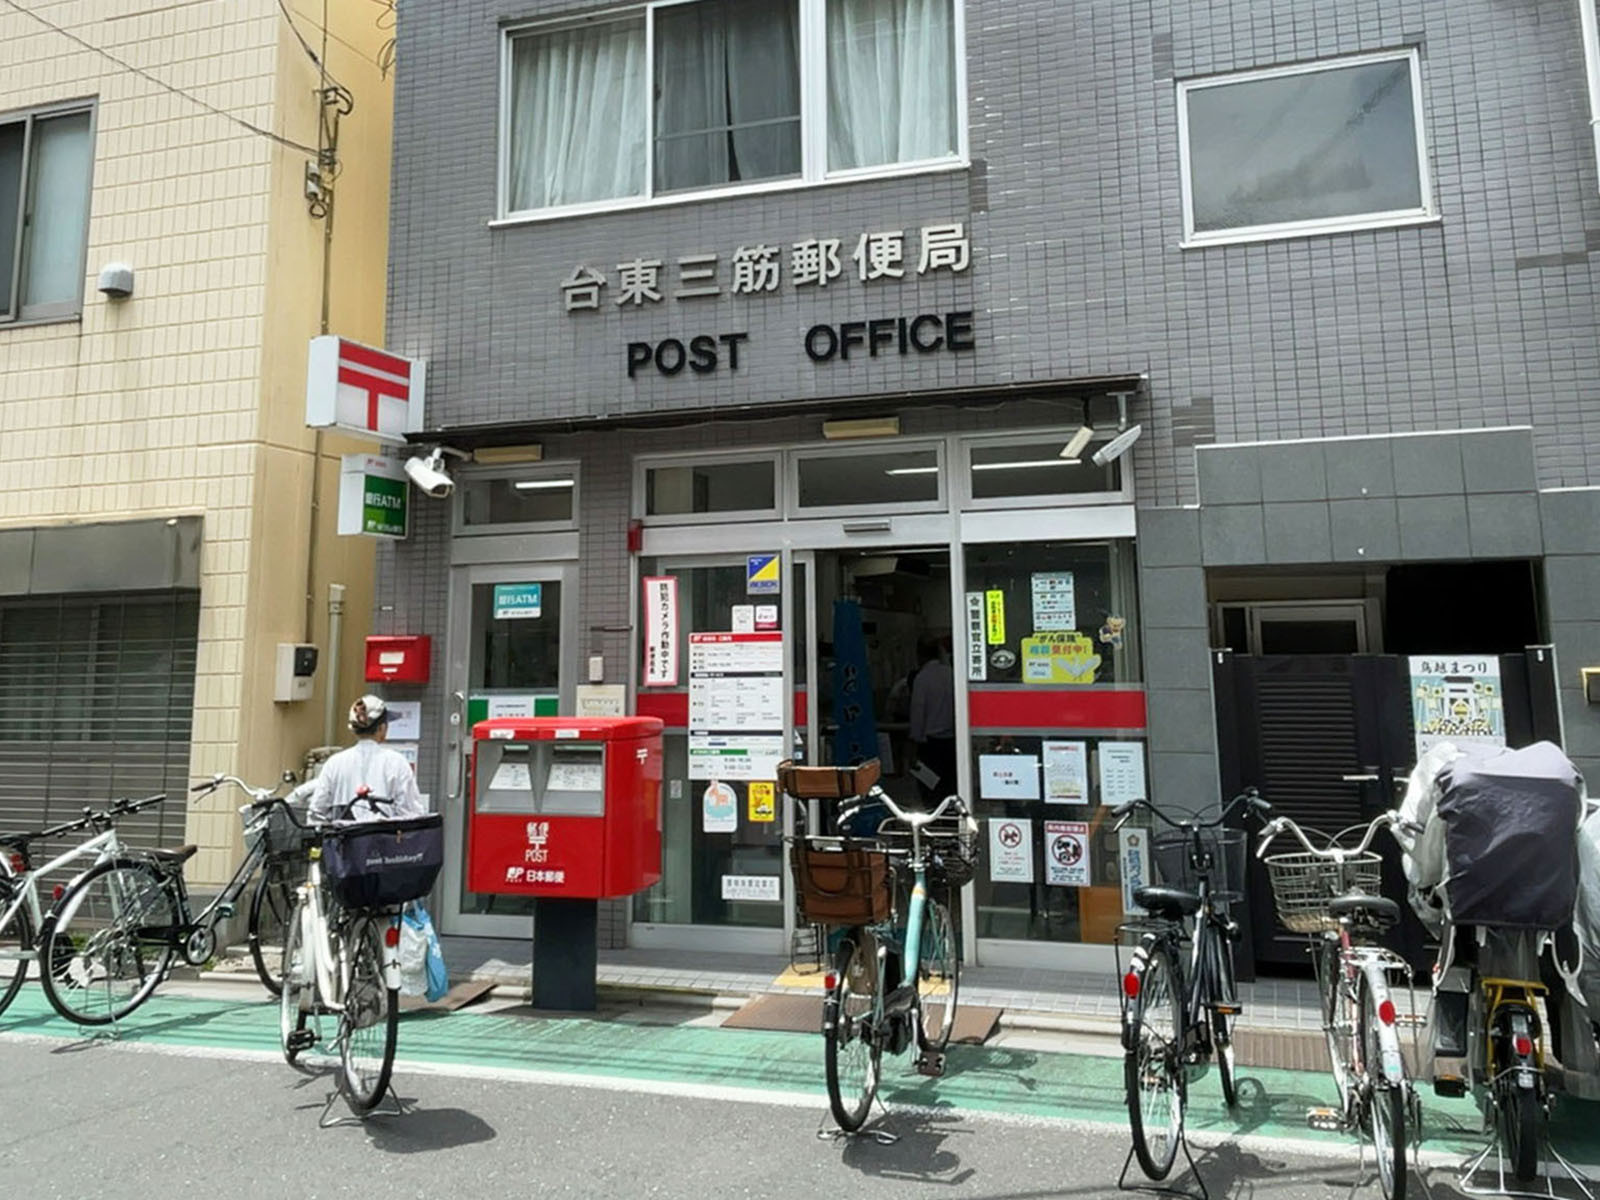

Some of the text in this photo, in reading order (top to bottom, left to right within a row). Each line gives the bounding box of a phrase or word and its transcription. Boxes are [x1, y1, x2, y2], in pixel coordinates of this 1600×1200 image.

[560, 222, 971, 312] 台東三筋郵便局
[627, 310, 976, 379] POST OFFICE
[1421, 660, 1487, 674] 鳥越まつり
[525, 849, 548, 863] POST
[526, 870, 565, 884] 日本郵便
